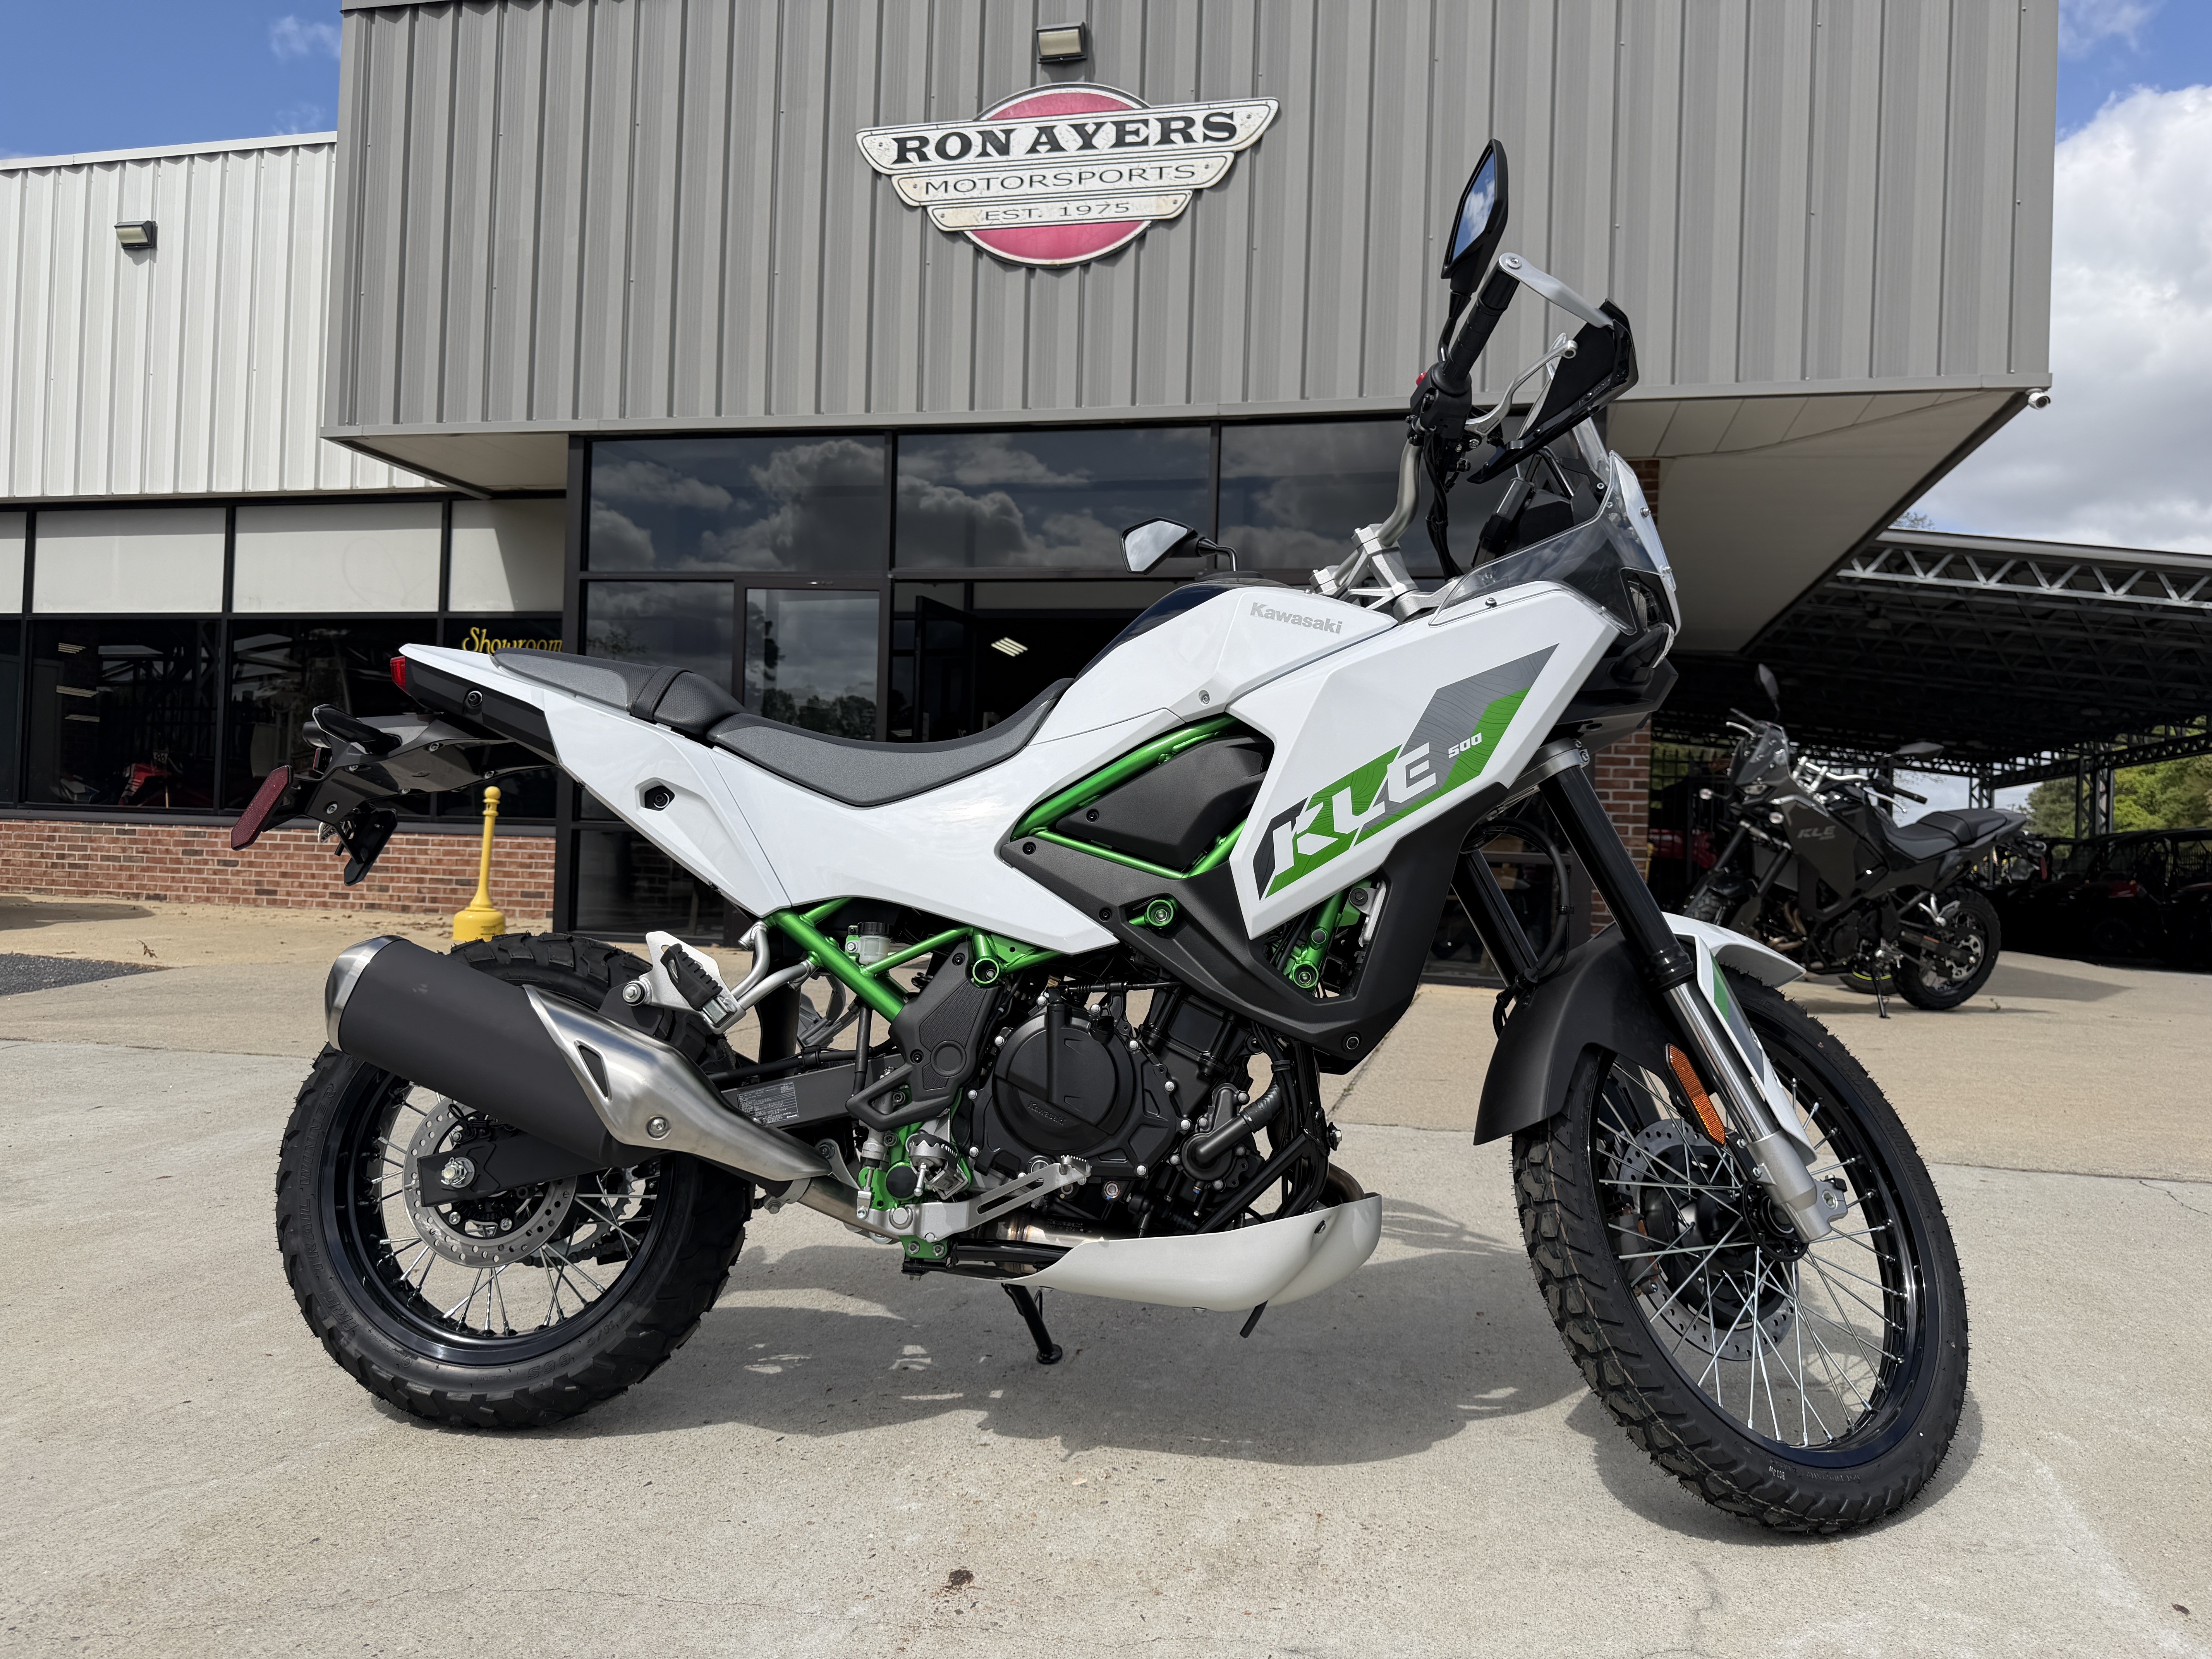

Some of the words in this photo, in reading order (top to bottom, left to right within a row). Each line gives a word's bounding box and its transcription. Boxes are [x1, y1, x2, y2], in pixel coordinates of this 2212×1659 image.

[891, 129, 1011, 165] RON
[1029, 112, 1237, 154] AYERS
[925, 165, 1195, 195] MOTORSPORTS
[985, 209, 1043, 222] EST.
[1061, 203, 1130, 217] 1975
[1250, 602, 1343, 634] Kawasaki
[462, 627, 562, 655] Showroom
[1448, 732, 1482, 759] 500
[1273, 742, 1436, 876] KLE
[1028, 1102, 1066, 1126] Kawasaki
[300, 1084, 336, 1185] WINNER
[300, 1198, 324, 1273] TRAIL
